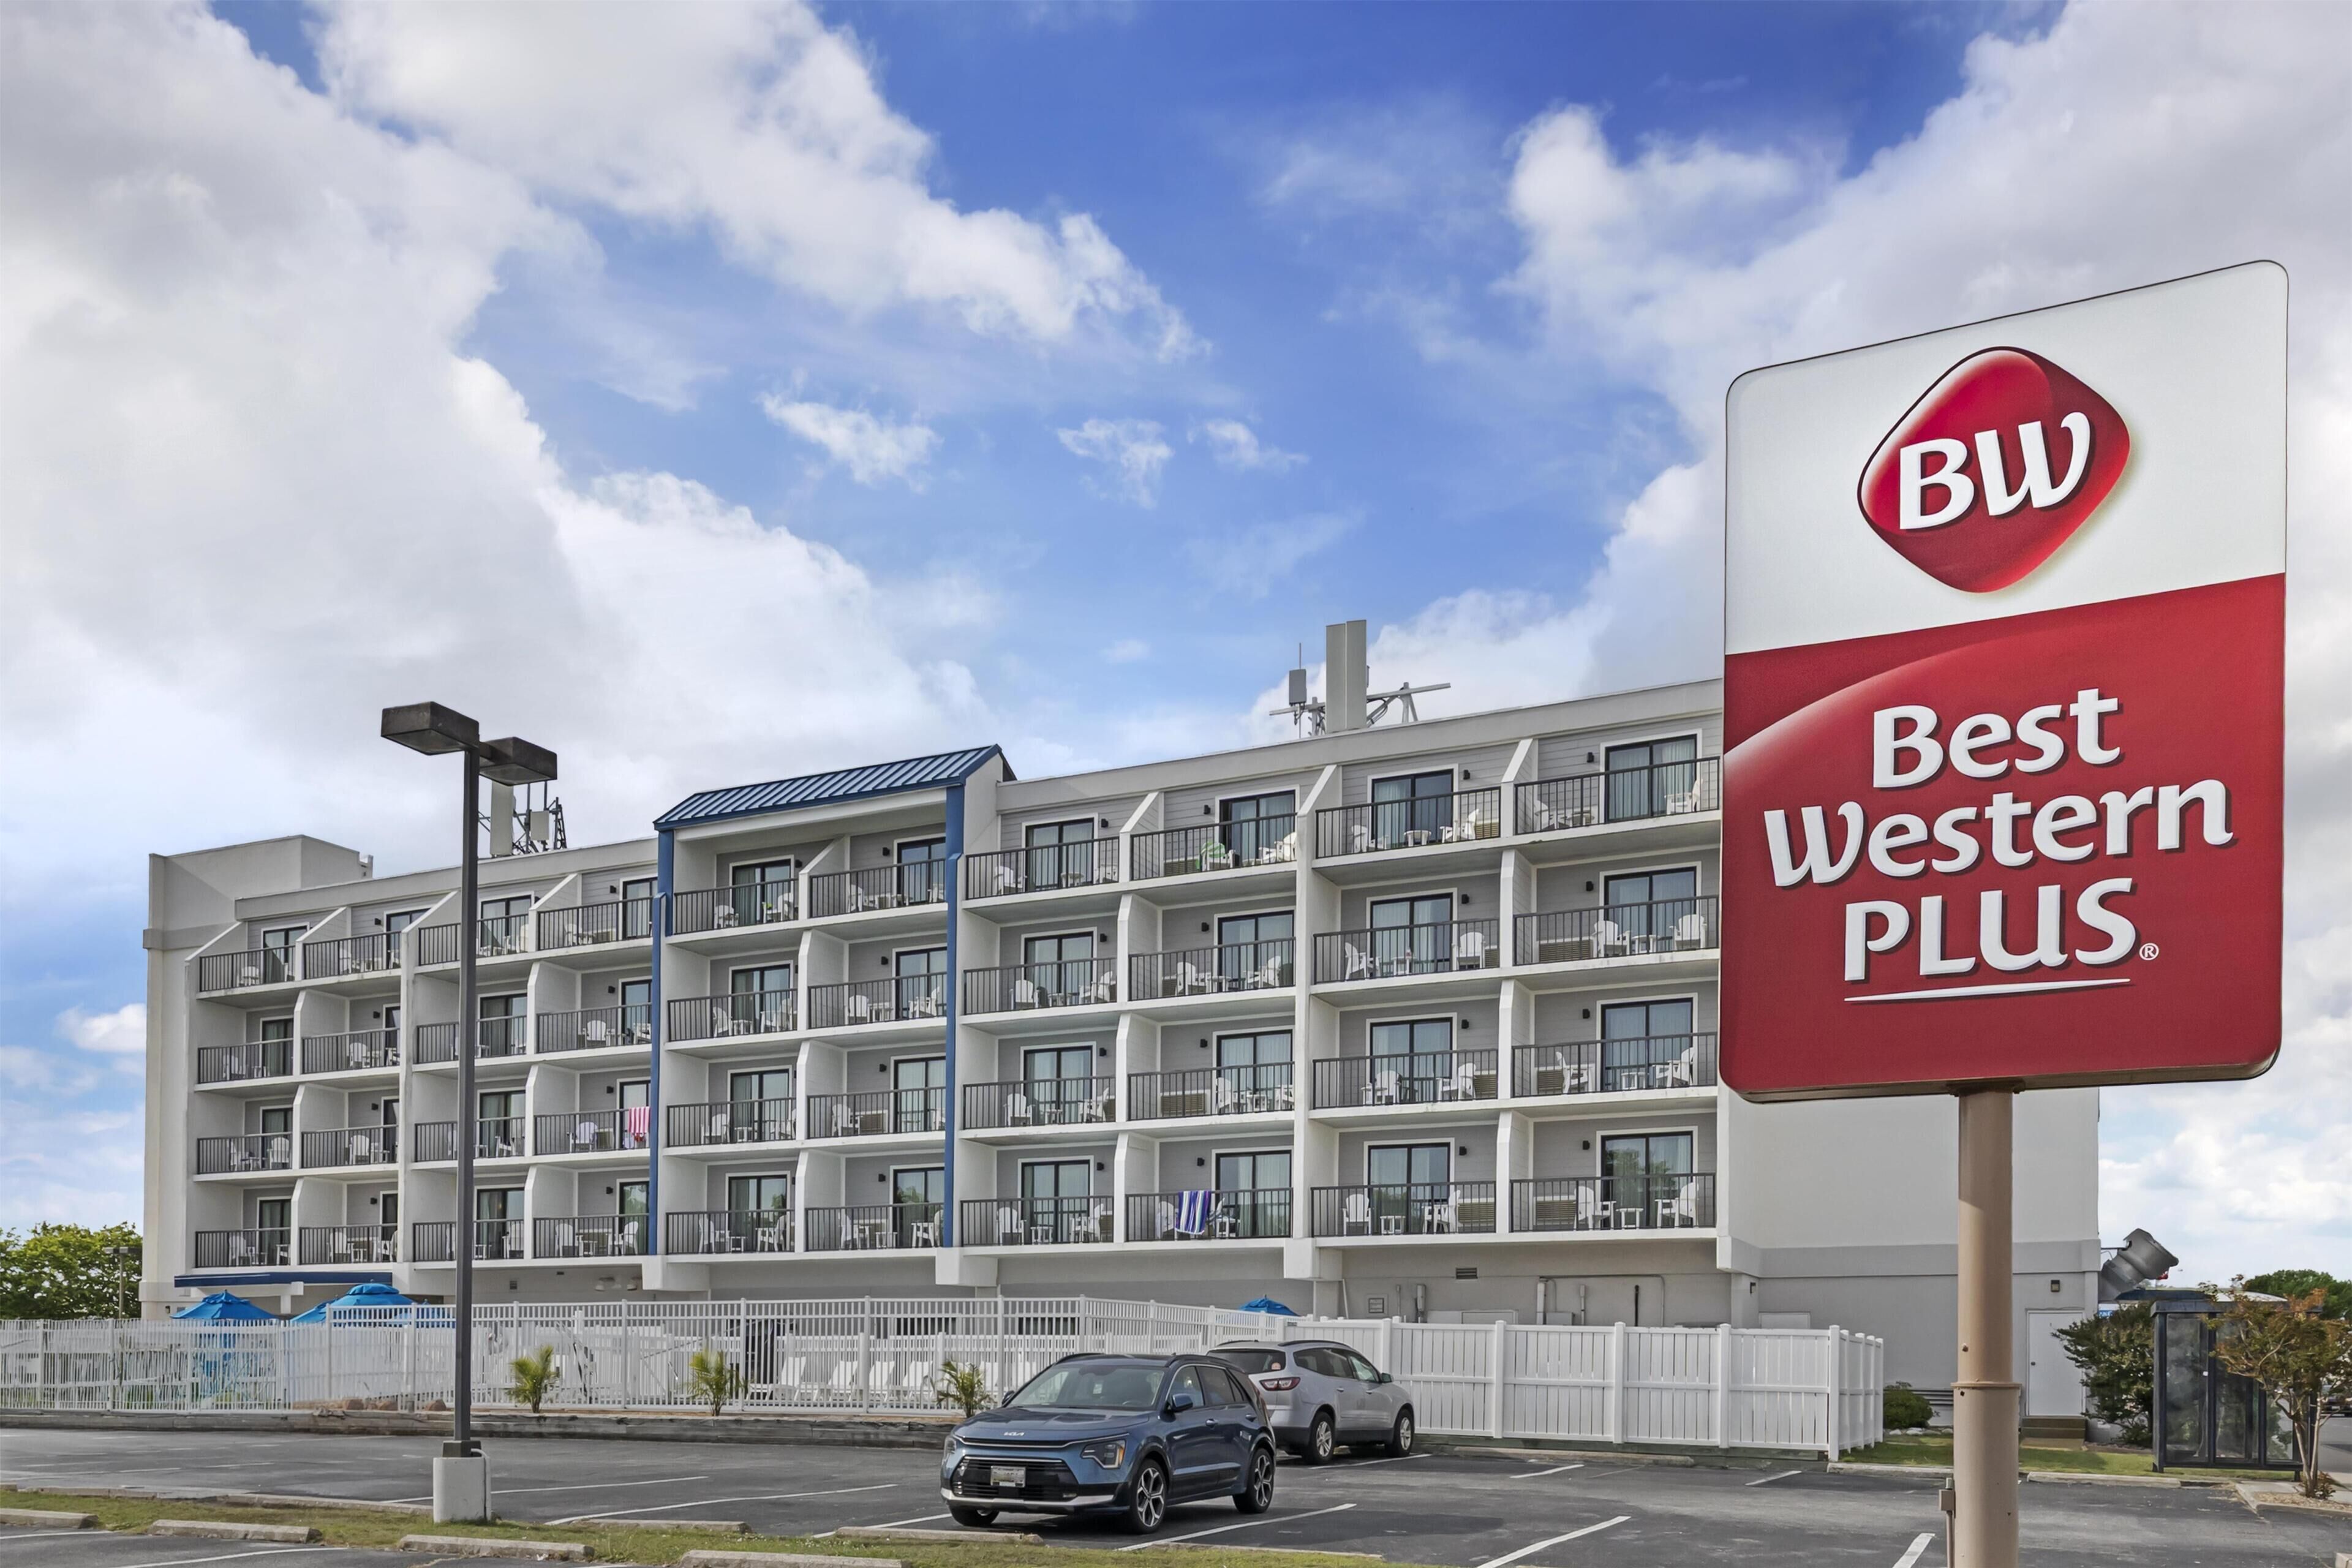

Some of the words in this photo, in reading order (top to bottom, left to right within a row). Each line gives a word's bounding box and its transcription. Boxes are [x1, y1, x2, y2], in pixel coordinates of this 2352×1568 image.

[1899, 412, 2090, 530] BW
[1873, 688, 2120, 788] Best
[1763, 779, 2233, 887] Western
